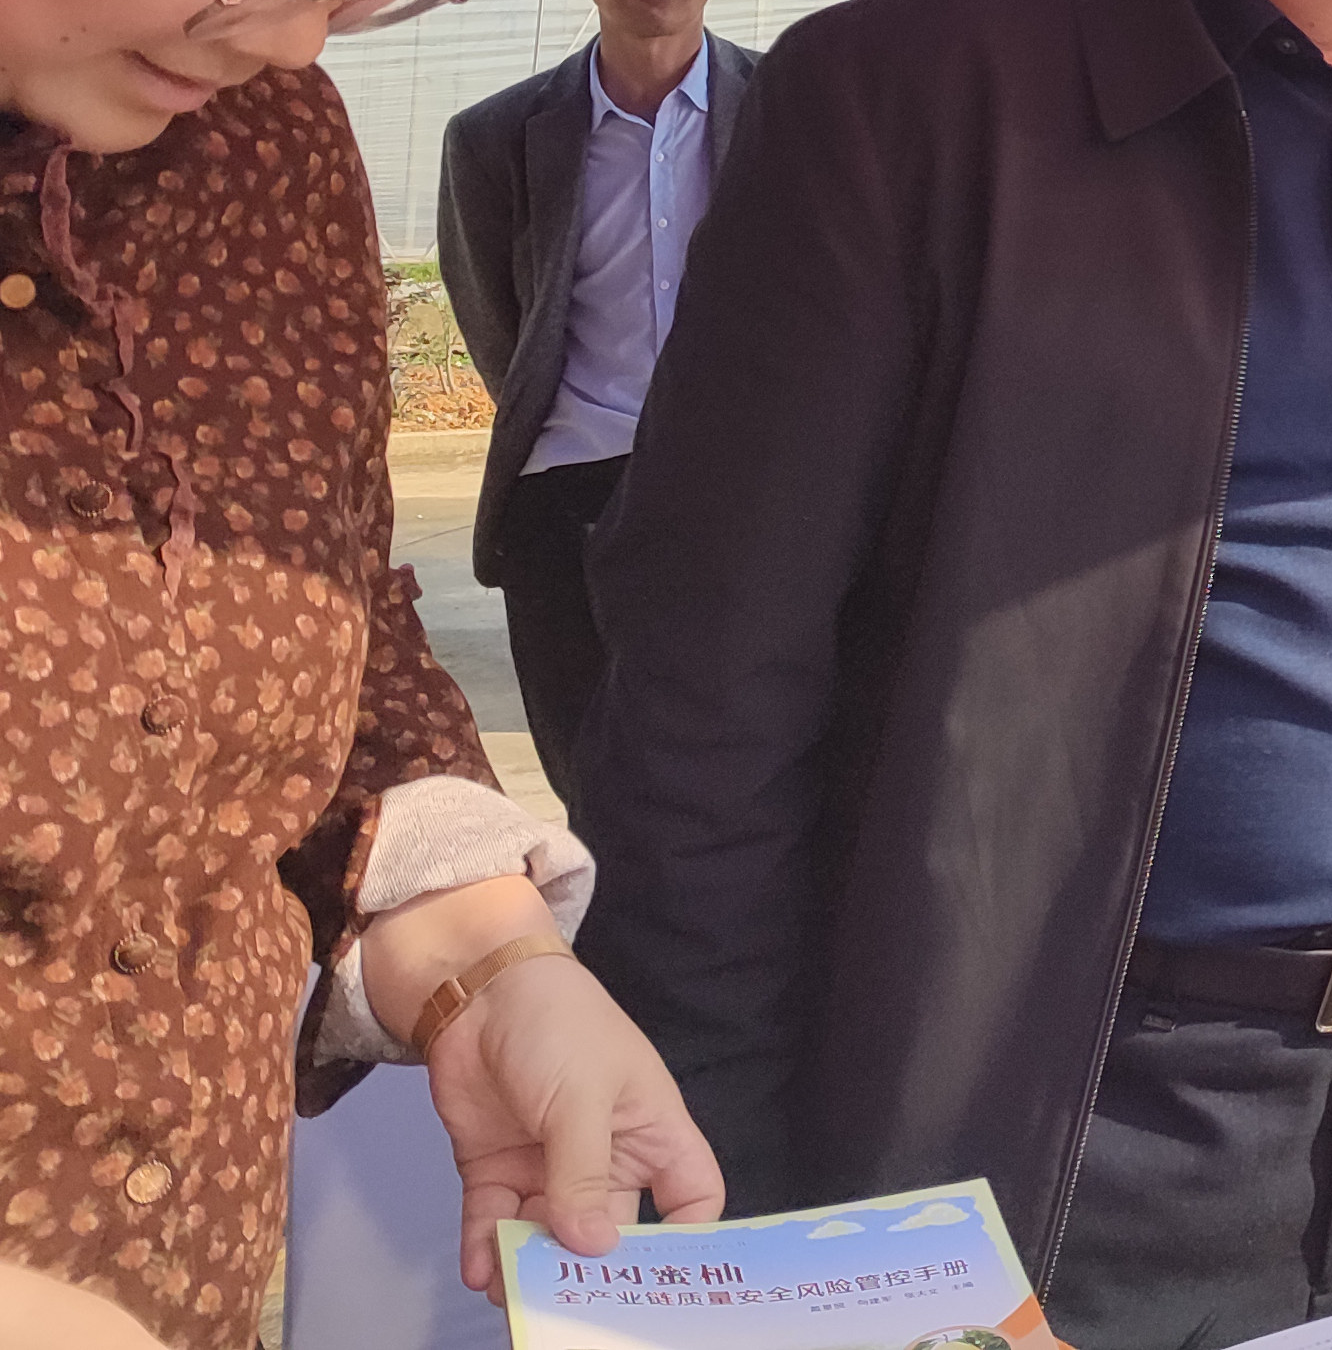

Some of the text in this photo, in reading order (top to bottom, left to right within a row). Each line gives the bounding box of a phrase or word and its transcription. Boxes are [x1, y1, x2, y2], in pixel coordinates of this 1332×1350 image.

[553, 1258, 970, 1307] 全产业链质量安全风险管控手册
